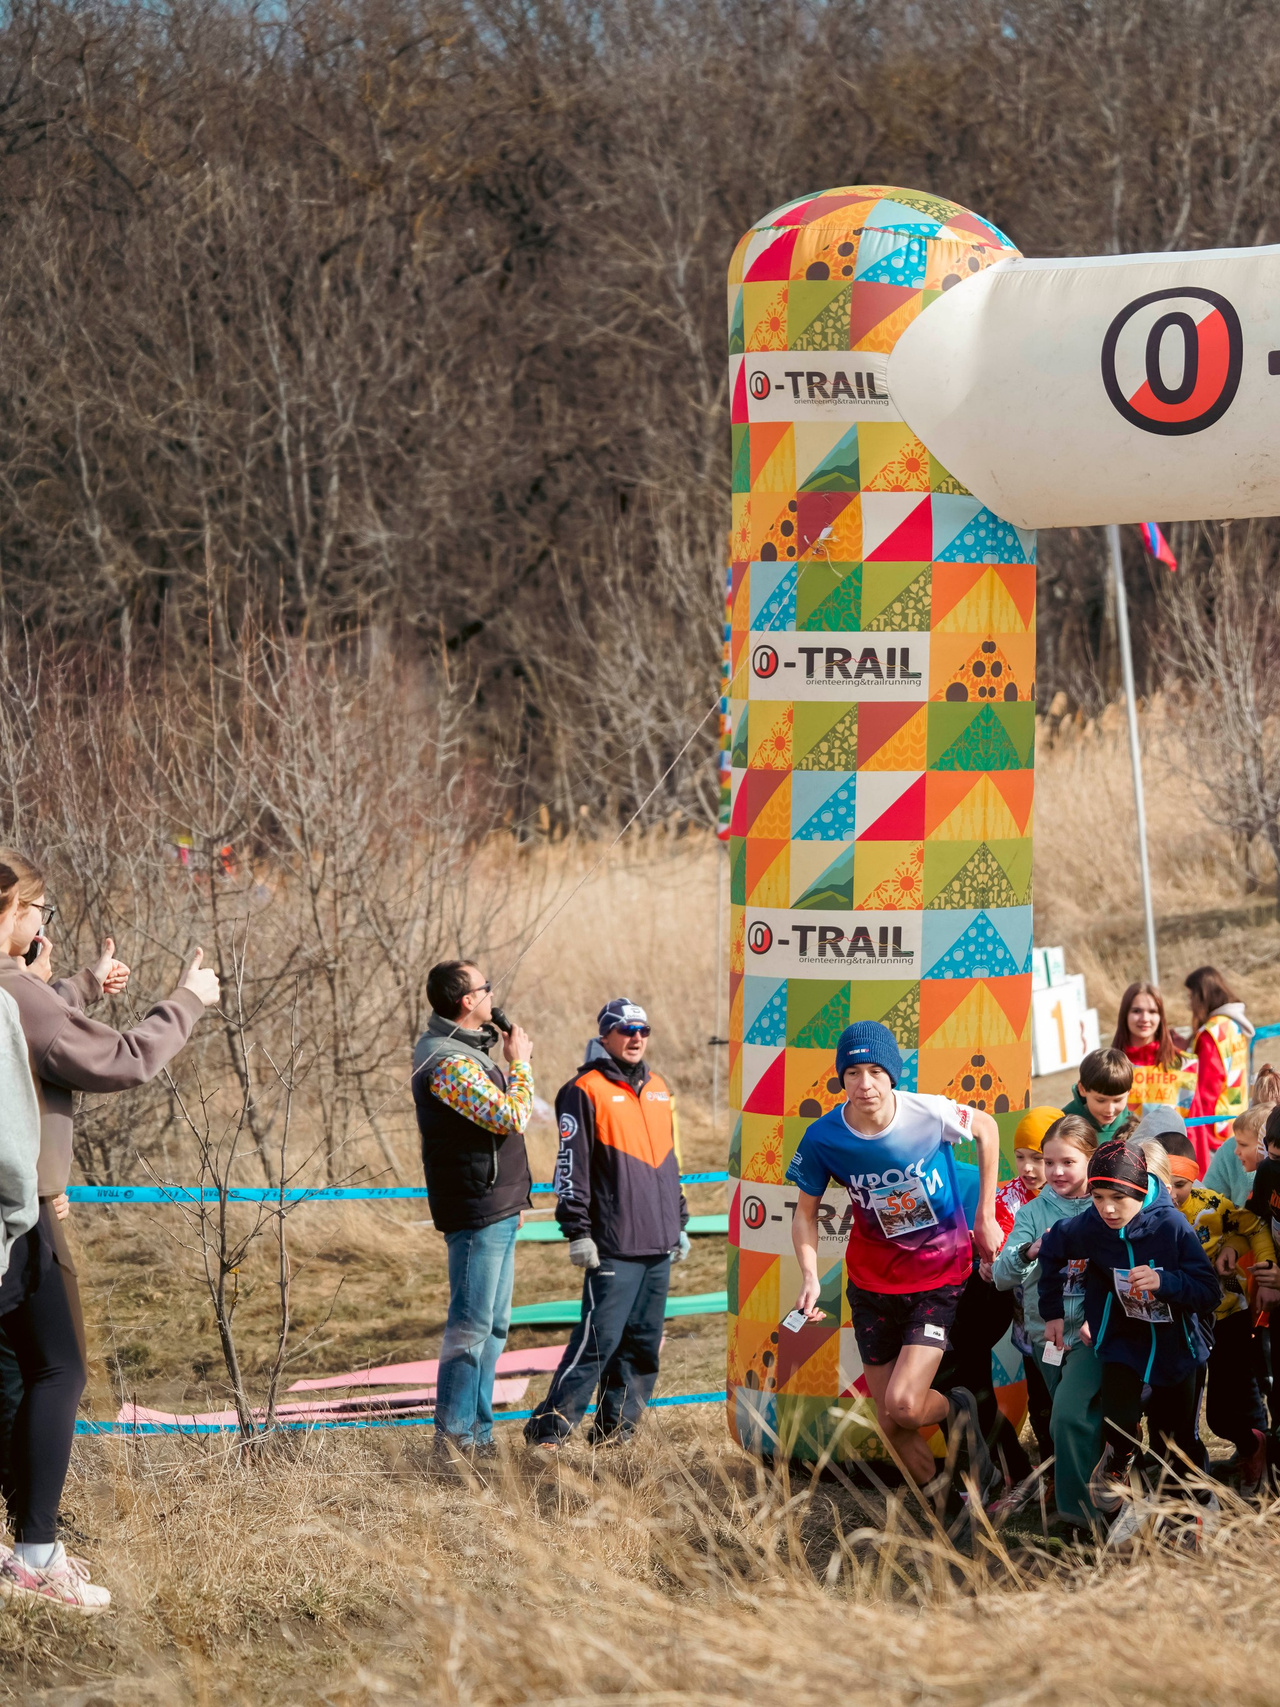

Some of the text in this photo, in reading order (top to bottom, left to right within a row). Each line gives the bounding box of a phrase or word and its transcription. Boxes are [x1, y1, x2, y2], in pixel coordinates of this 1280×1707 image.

[794, 397, 889, 406] orienteering&trailrunning
[805, 677, 922, 688] orienteering&trailrunning
[798, 955, 914, 965] orienteering&trailrunning
[1050, 1000, 1068, 1064] 1
[1133, 1072, 1178, 1085] ОНТЕР
[1154, 1087, 1174, 1102] ДЕЛ
[849, 1158, 926, 1191] КРОСС
[886, 1191, 916, 1216] 56
